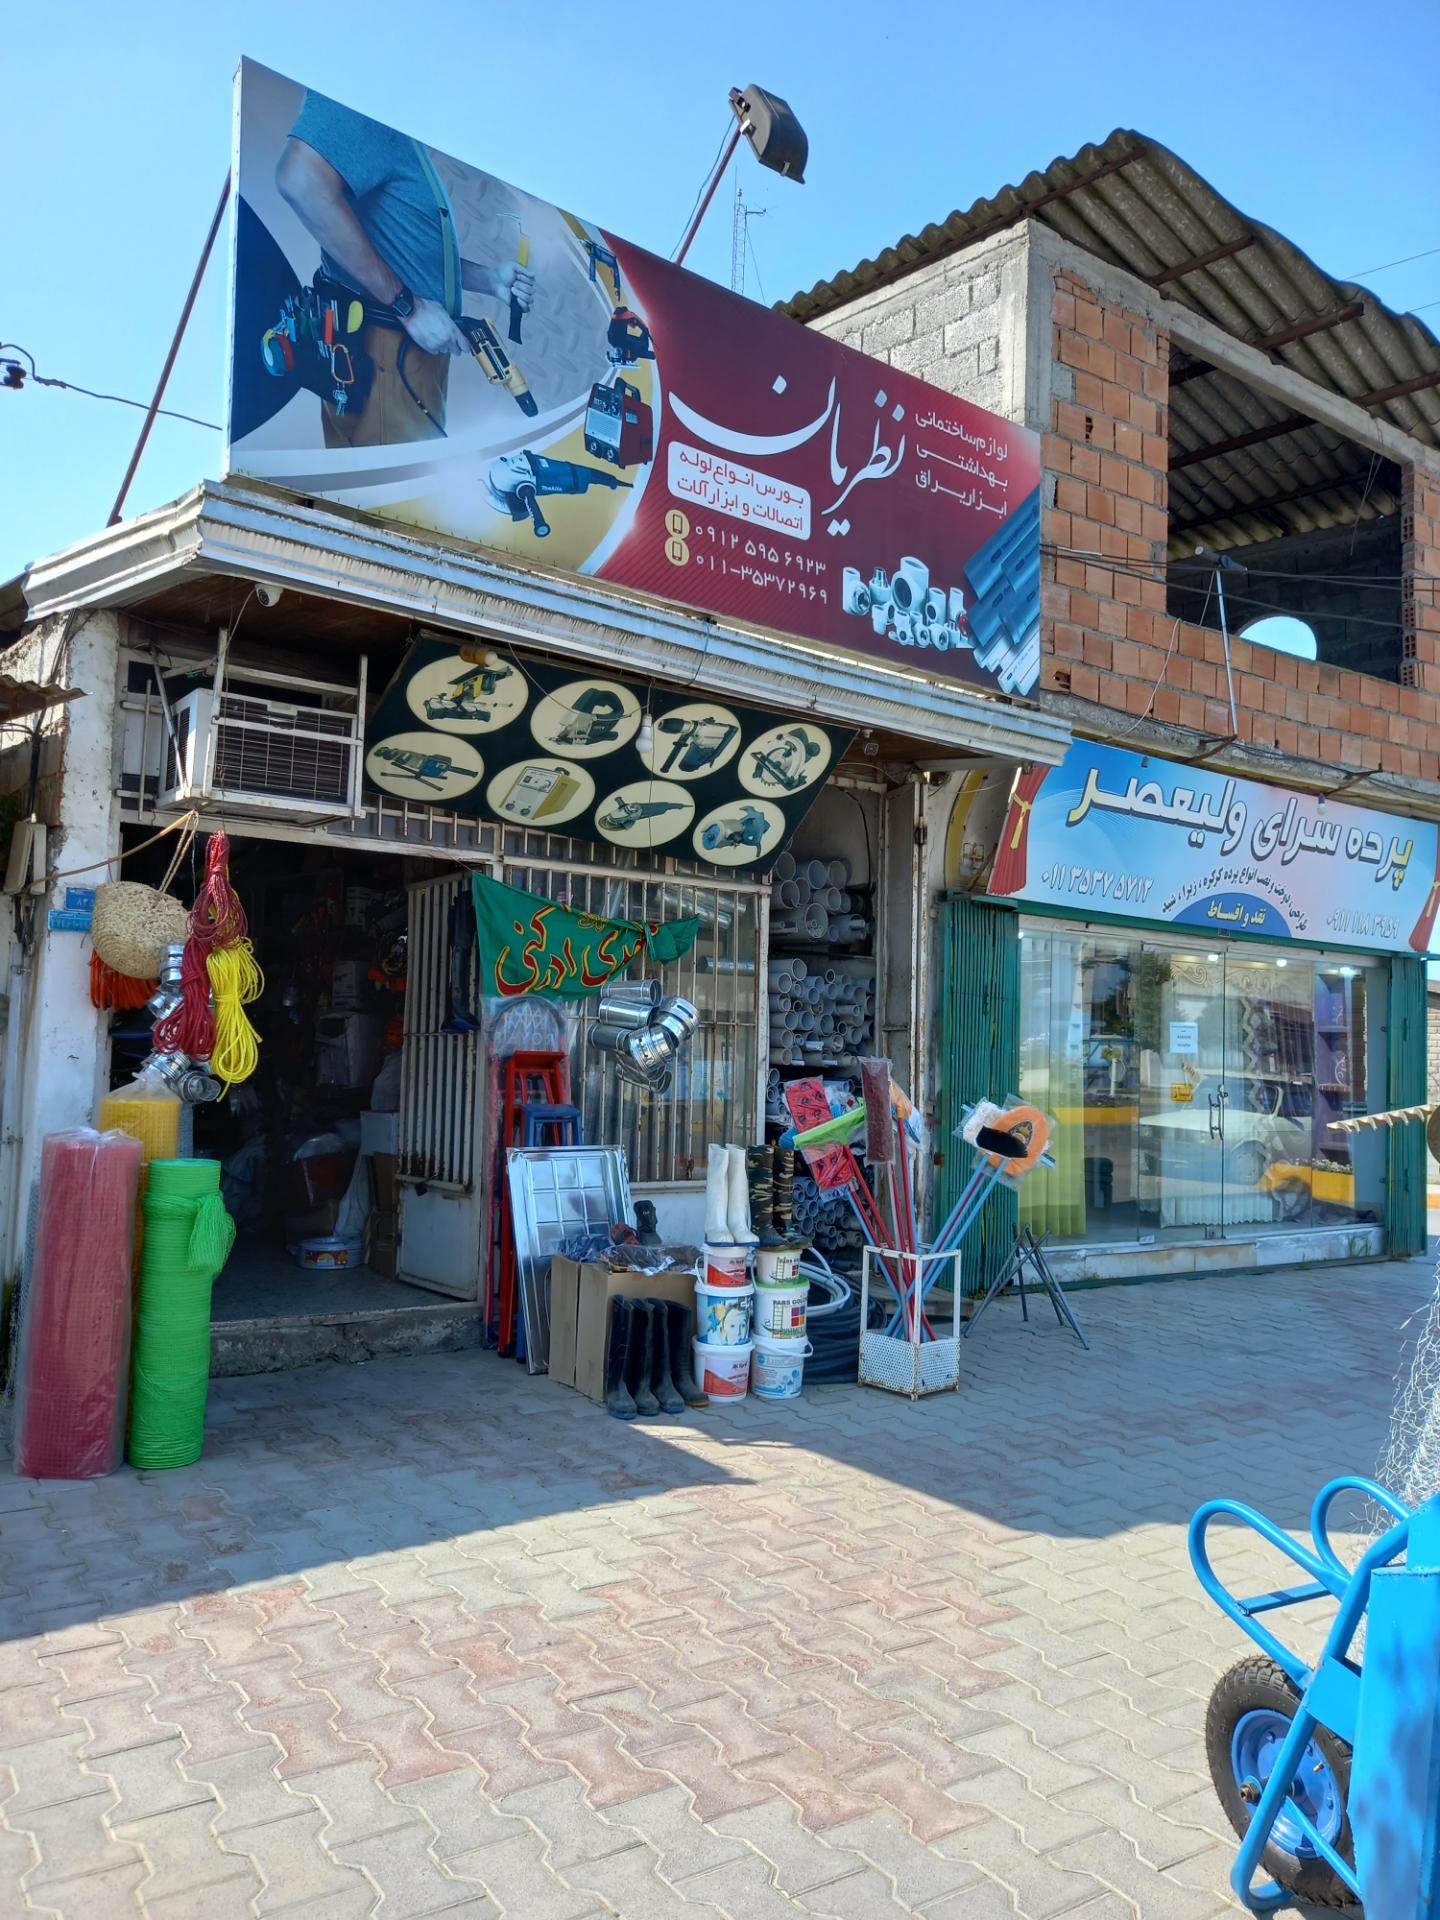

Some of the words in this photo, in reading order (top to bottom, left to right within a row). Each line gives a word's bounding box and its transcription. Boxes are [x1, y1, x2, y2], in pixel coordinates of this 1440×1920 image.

[915, 411, 977, 447] ساختمانی
[668, 374, 906, 538] نظریان
[680, 451, 712, 474] لوله
[916, 443, 1008, 492] بهداشتی
[713, 463, 754, 486] انواع
[677, 477, 709, 498] آلات
[708, 488, 738, 512] ابزار
[755, 483, 804, 509] بورس
[742, 502, 750, 516] و
[752, 504, 803, 531] اتصالات
[1065, 768, 1247, 857] ولیعصر
[1251, 797, 1342, 866] سرای
[1346, 827, 1413, 890] پرده
[1207, 901, 1245, 922] اقساط
[1240, 912, 1250, 928] و
[1250, 907, 1267, 925] نقد
